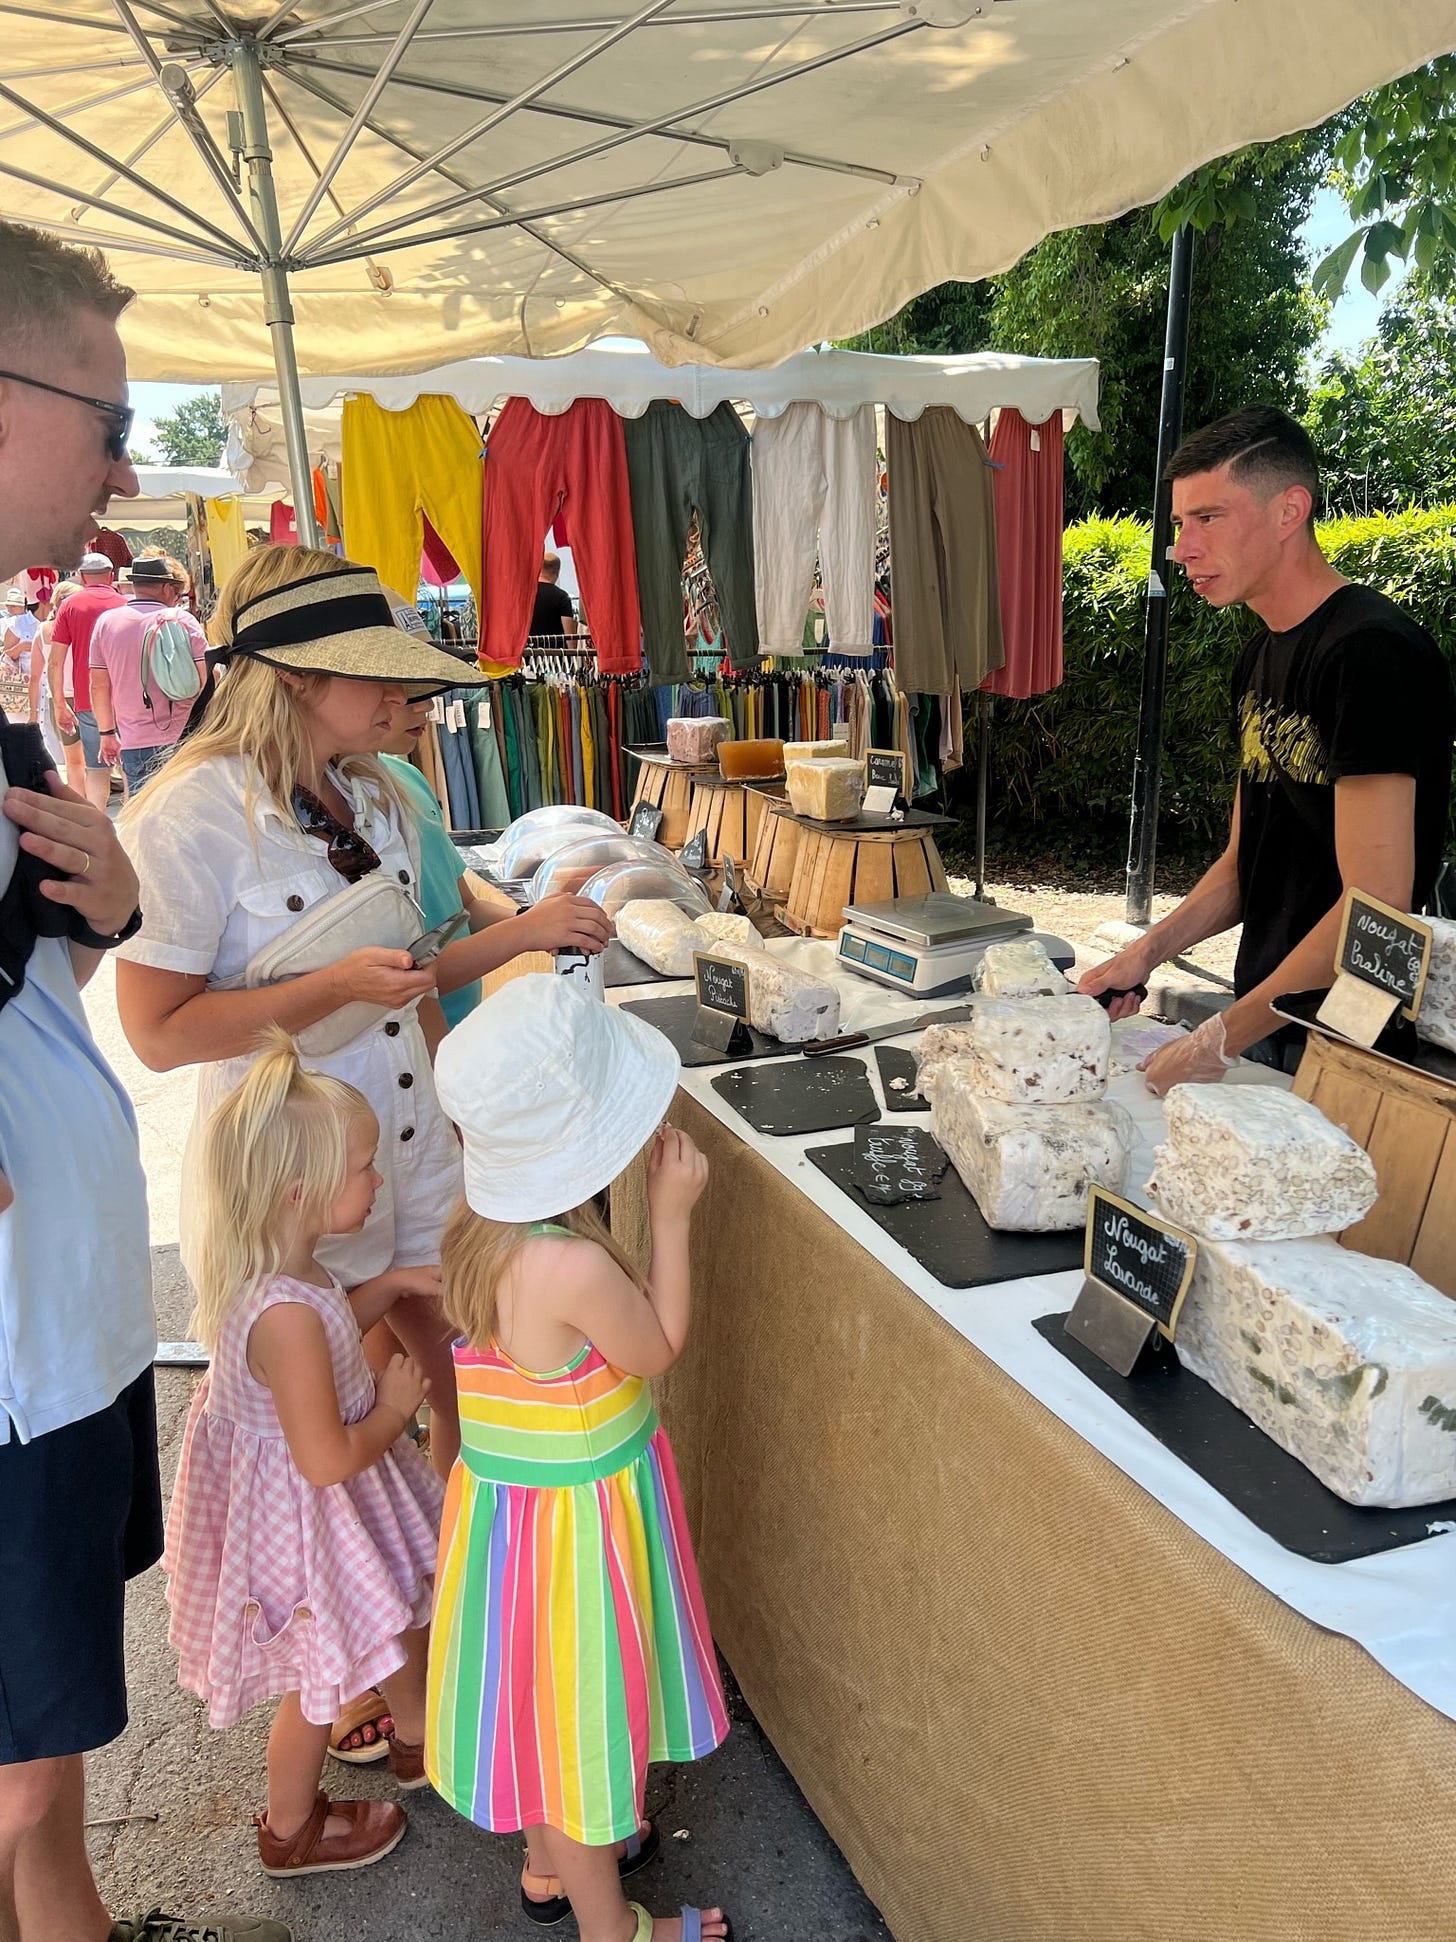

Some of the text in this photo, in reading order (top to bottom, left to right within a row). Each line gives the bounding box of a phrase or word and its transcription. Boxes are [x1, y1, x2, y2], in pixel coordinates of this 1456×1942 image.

[1357, 914, 1424, 956] Nougat
[703, 965, 733, 992] Nougat
[894, 1136, 926, 1176] Nougat
[1104, 1215, 1168, 1264] Nougat
[1104, 1244, 1160, 1305] Lavande
